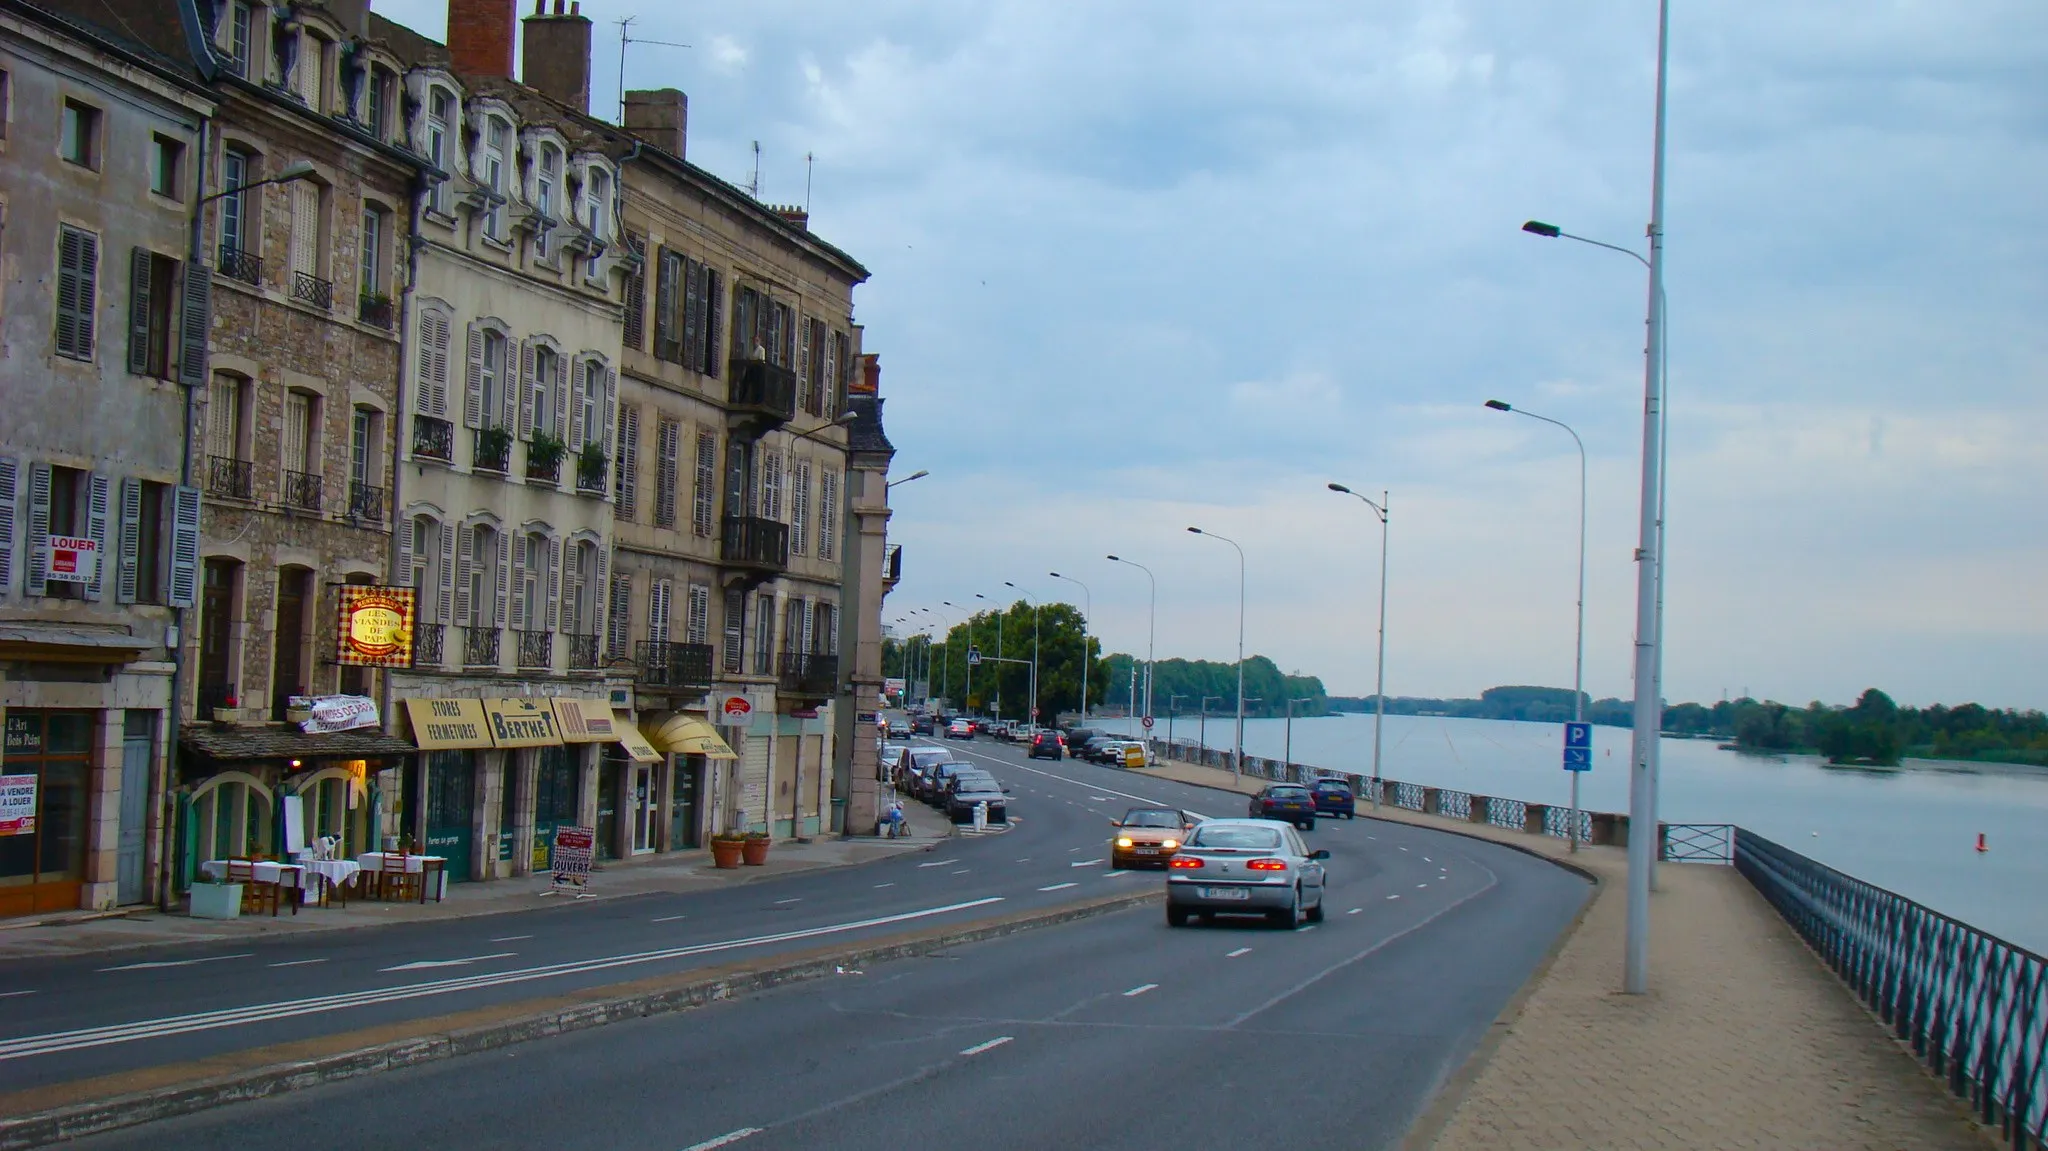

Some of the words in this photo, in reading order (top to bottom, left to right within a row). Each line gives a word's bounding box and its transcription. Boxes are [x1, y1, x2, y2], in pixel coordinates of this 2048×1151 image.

[51, 537, 95, 551] LOUER
[356, 598, 399, 610] RESTAURANT
[368, 610, 387, 618] LES
[354, 618, 400, 627] VIANDES
[369, 627, 384, 635] DE
[364, 635, 388, 643] PAPA
[344, 705, 357, 716] DE
[431, 700, 462, 717] STORES
[316, 717, 357, 731] RESTAURANT
[492, 711, 555, 739] BERTHET
[426, 723, 478, 741] FERMETURES
[1572, 727, 1585, 743] P
[7, 786, 34, 796] VENDRE
[2, 798, 7, 806] A
[9, 796, 32, 806] LOUER
[554, 861, 589, 872] OUVERT
